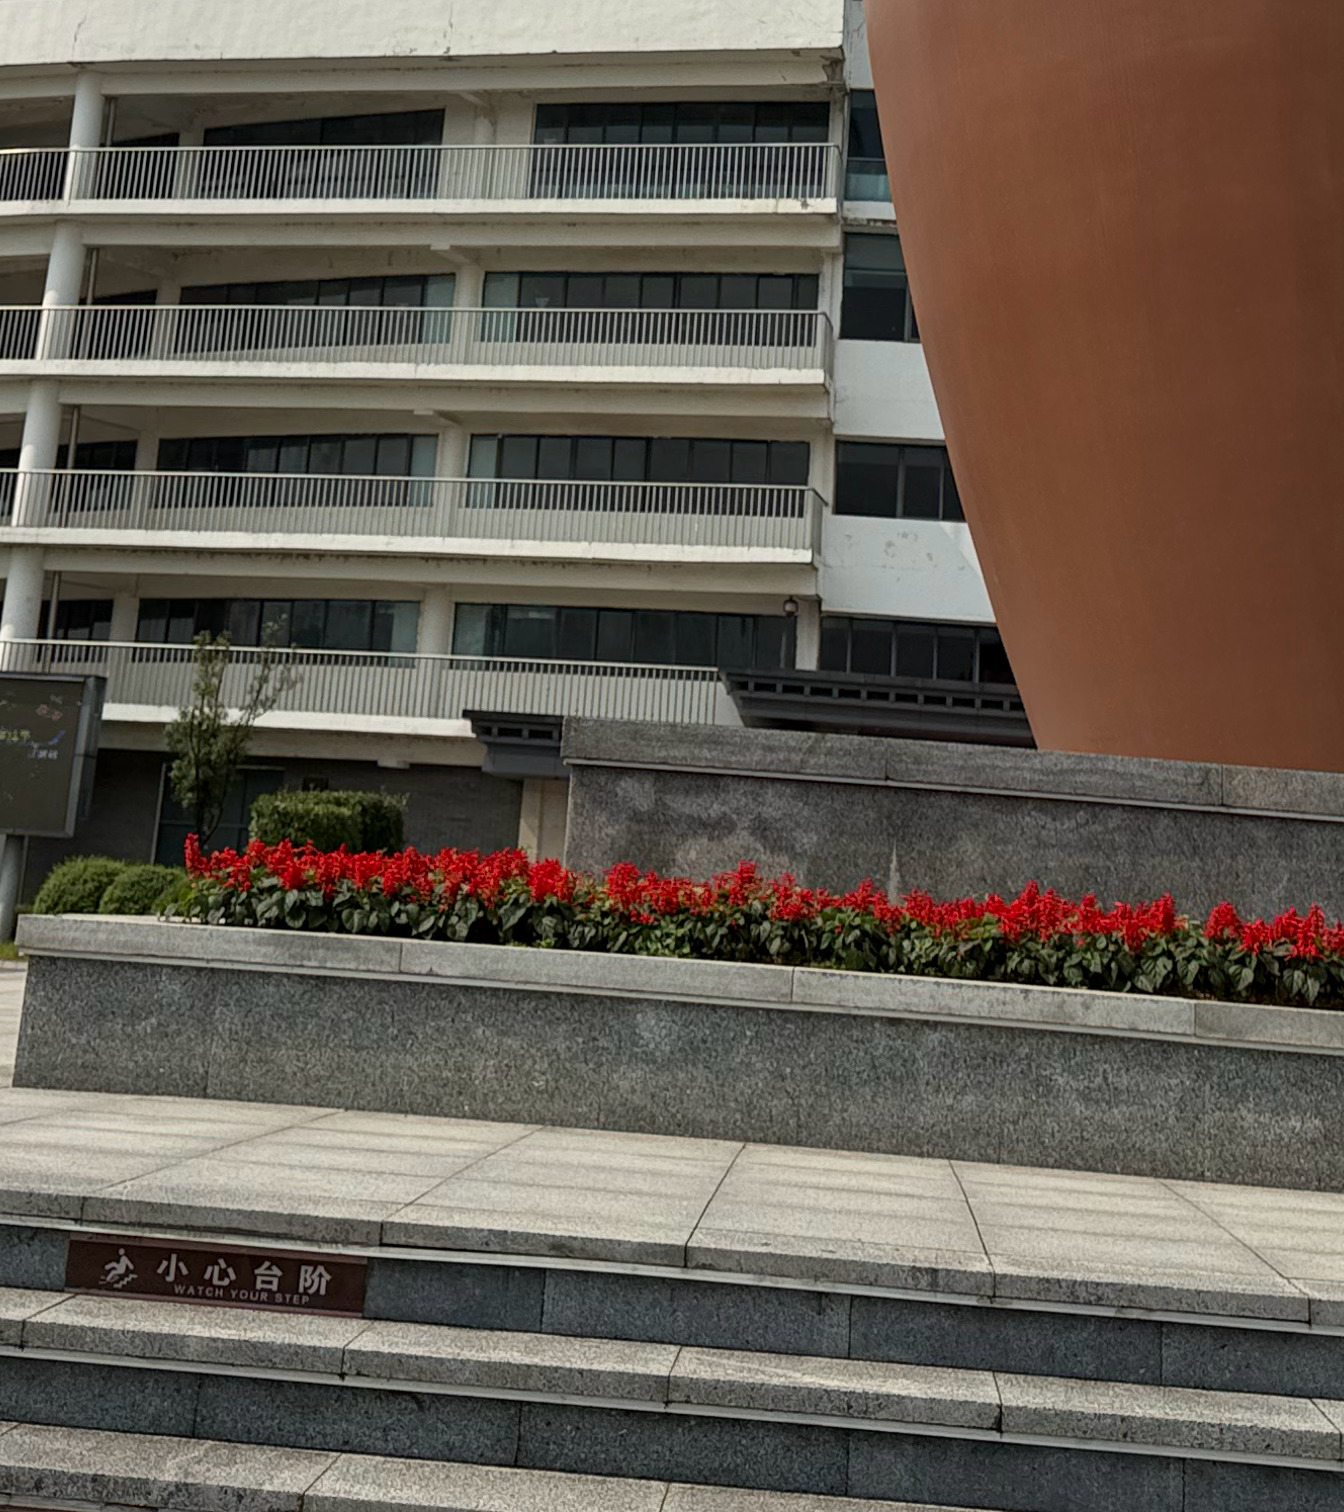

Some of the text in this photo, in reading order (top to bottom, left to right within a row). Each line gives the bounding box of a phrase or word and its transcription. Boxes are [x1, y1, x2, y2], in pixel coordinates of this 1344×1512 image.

[157, 1253, 332, 1296] 小心台阶
[174, 1284, 310, 1305] WATCH YOUR STEP
